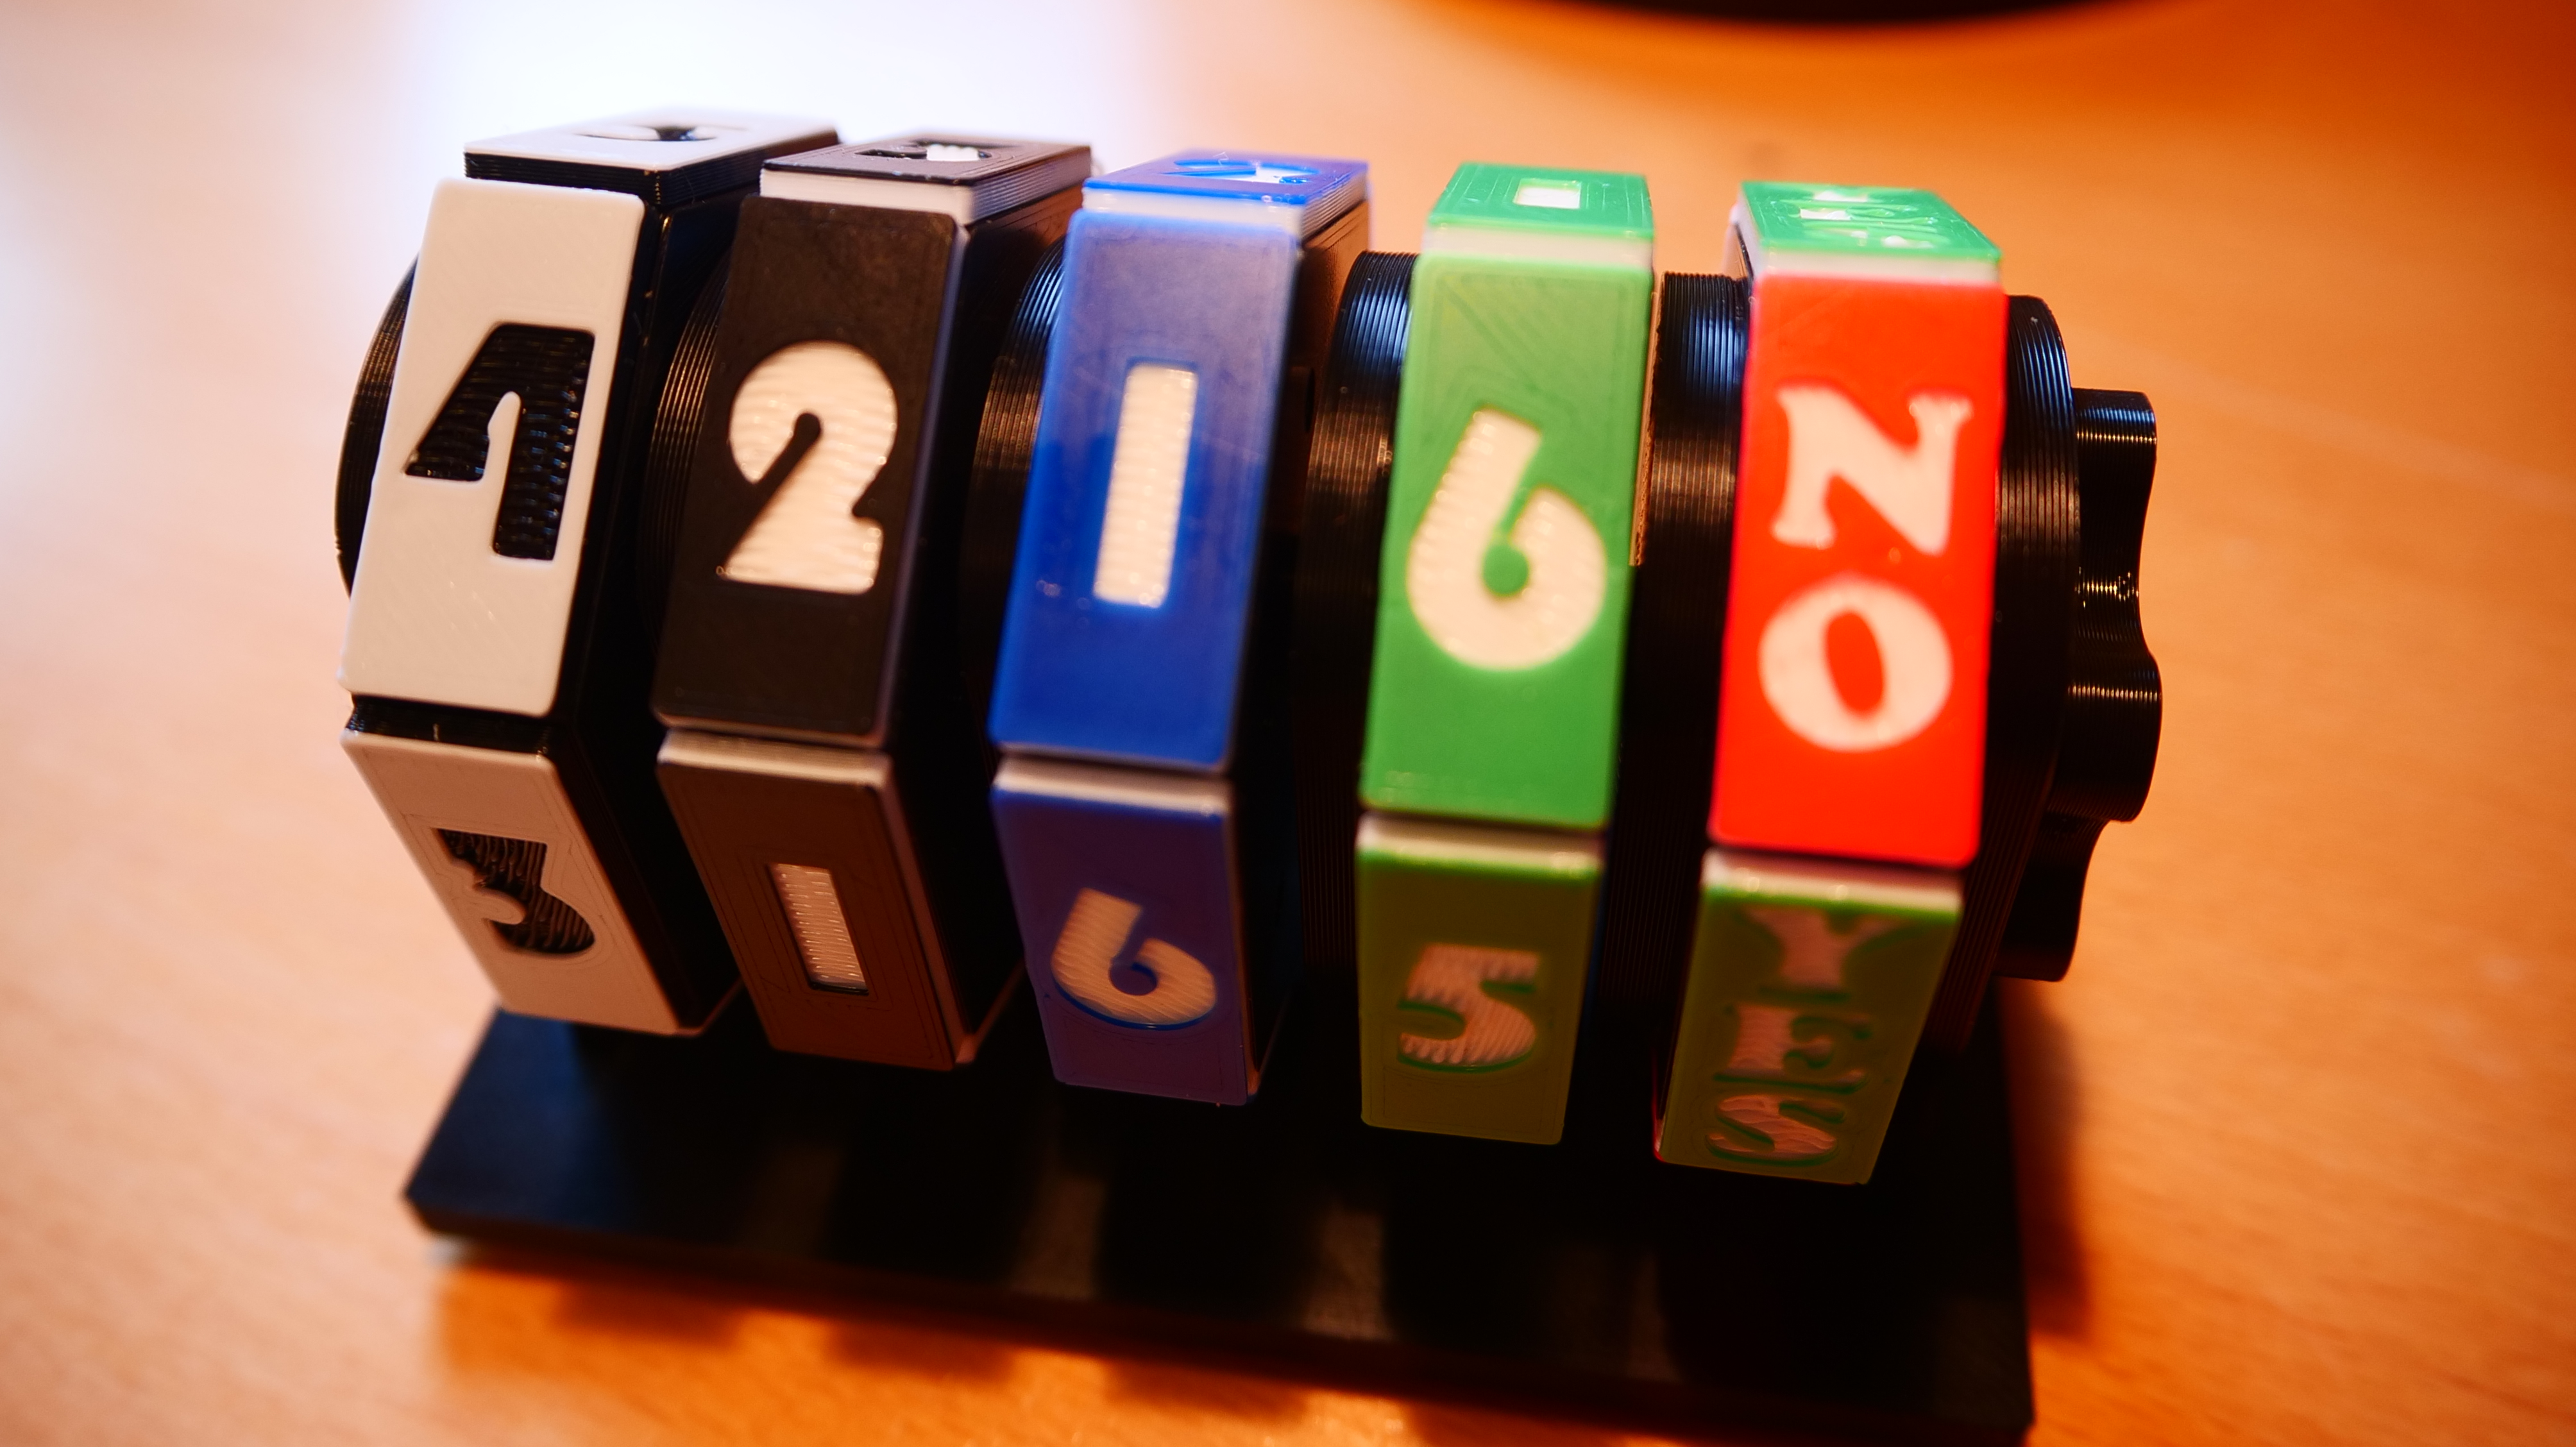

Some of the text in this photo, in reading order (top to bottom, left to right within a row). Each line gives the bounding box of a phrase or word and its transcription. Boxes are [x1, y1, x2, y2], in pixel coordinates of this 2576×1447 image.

[717, 340, 897, 595] 2
[1406, 405, 1607, 671] 6
[1756, 385, 1974, 752] NO
[434, 827, 596, 955] 3
[1050, 886, 1217, 1030] 6
[1396, 942, 1539, 1073] 5
[1705, 902, 1923, 1167] YES
